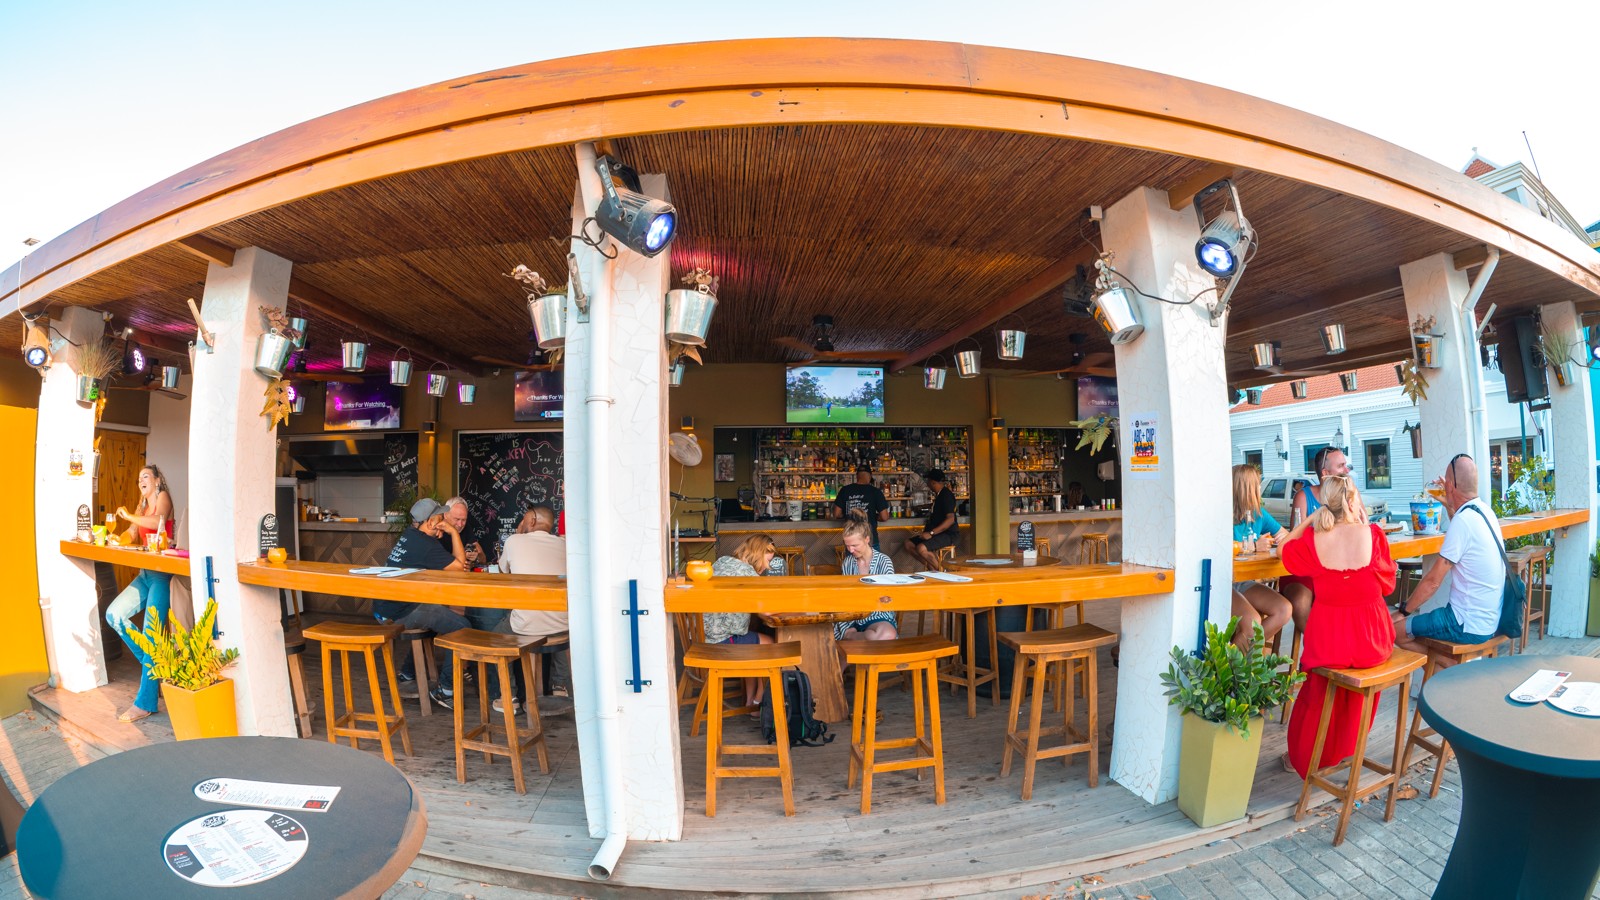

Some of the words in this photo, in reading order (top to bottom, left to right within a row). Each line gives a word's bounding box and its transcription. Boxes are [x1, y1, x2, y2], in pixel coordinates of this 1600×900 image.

[339, 401, 355, 409] Thanks
[1146, 428, 1154, 442] CUP
[512, 438, 520, 448] IS
[507, 448, 525, 459] KEY
